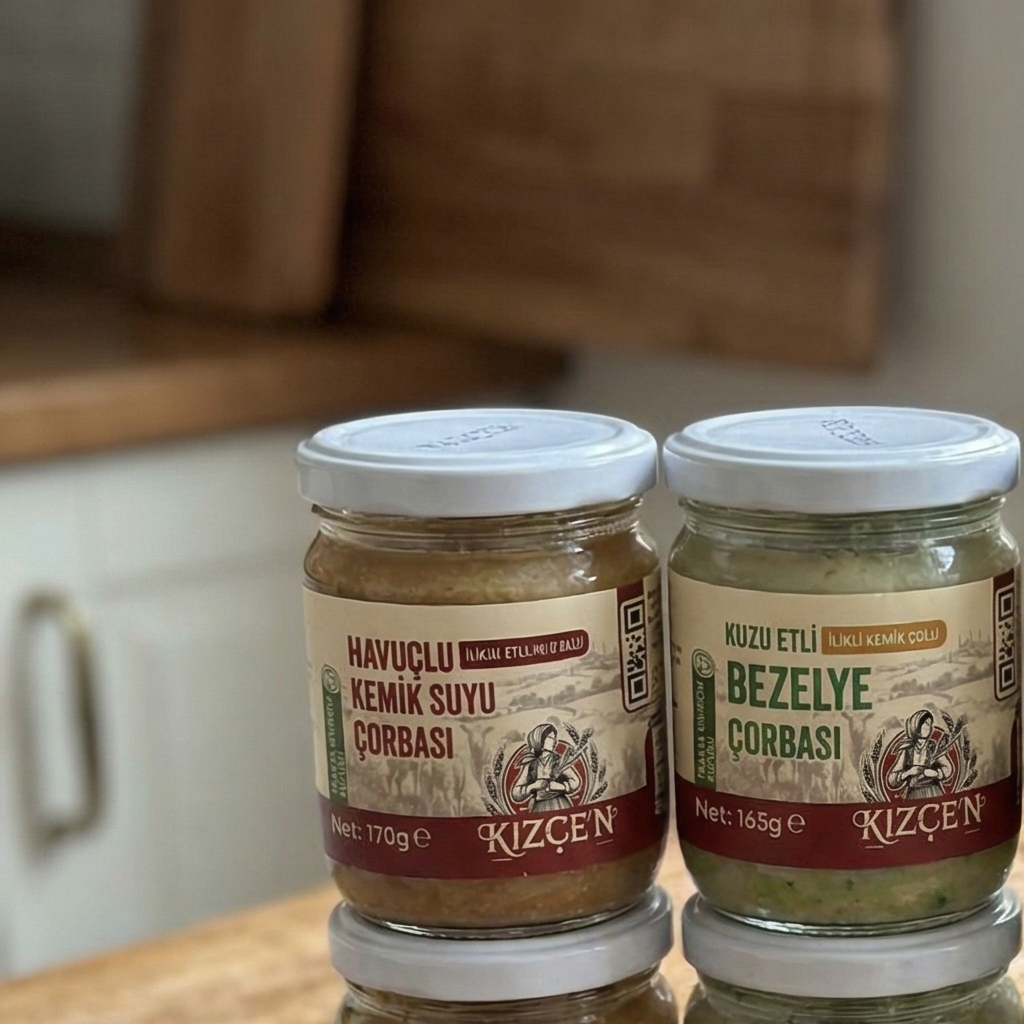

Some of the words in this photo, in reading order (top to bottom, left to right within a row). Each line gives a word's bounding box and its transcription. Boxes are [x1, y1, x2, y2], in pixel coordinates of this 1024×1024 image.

[347, 635, 454, 678] HAVUÇLU
[725, 621, 771, 651] KUZU
[777, 624, 817, 653] ETLİ
[351, 674, 423, 715] KEMİK
[429, 681, 496, 716] SUYU
[727, 660, 873, 712] BEZELYE
[354, 720, 454, 762] ÇORBASI
[728, 718, 841, 762] ÇORBASI
[331, 813, 362, 840] Net:
[366, 824, 410, 852] 170g
[695, 797, 732, 826] Net:
[737, 809, 782, 838] 165g
